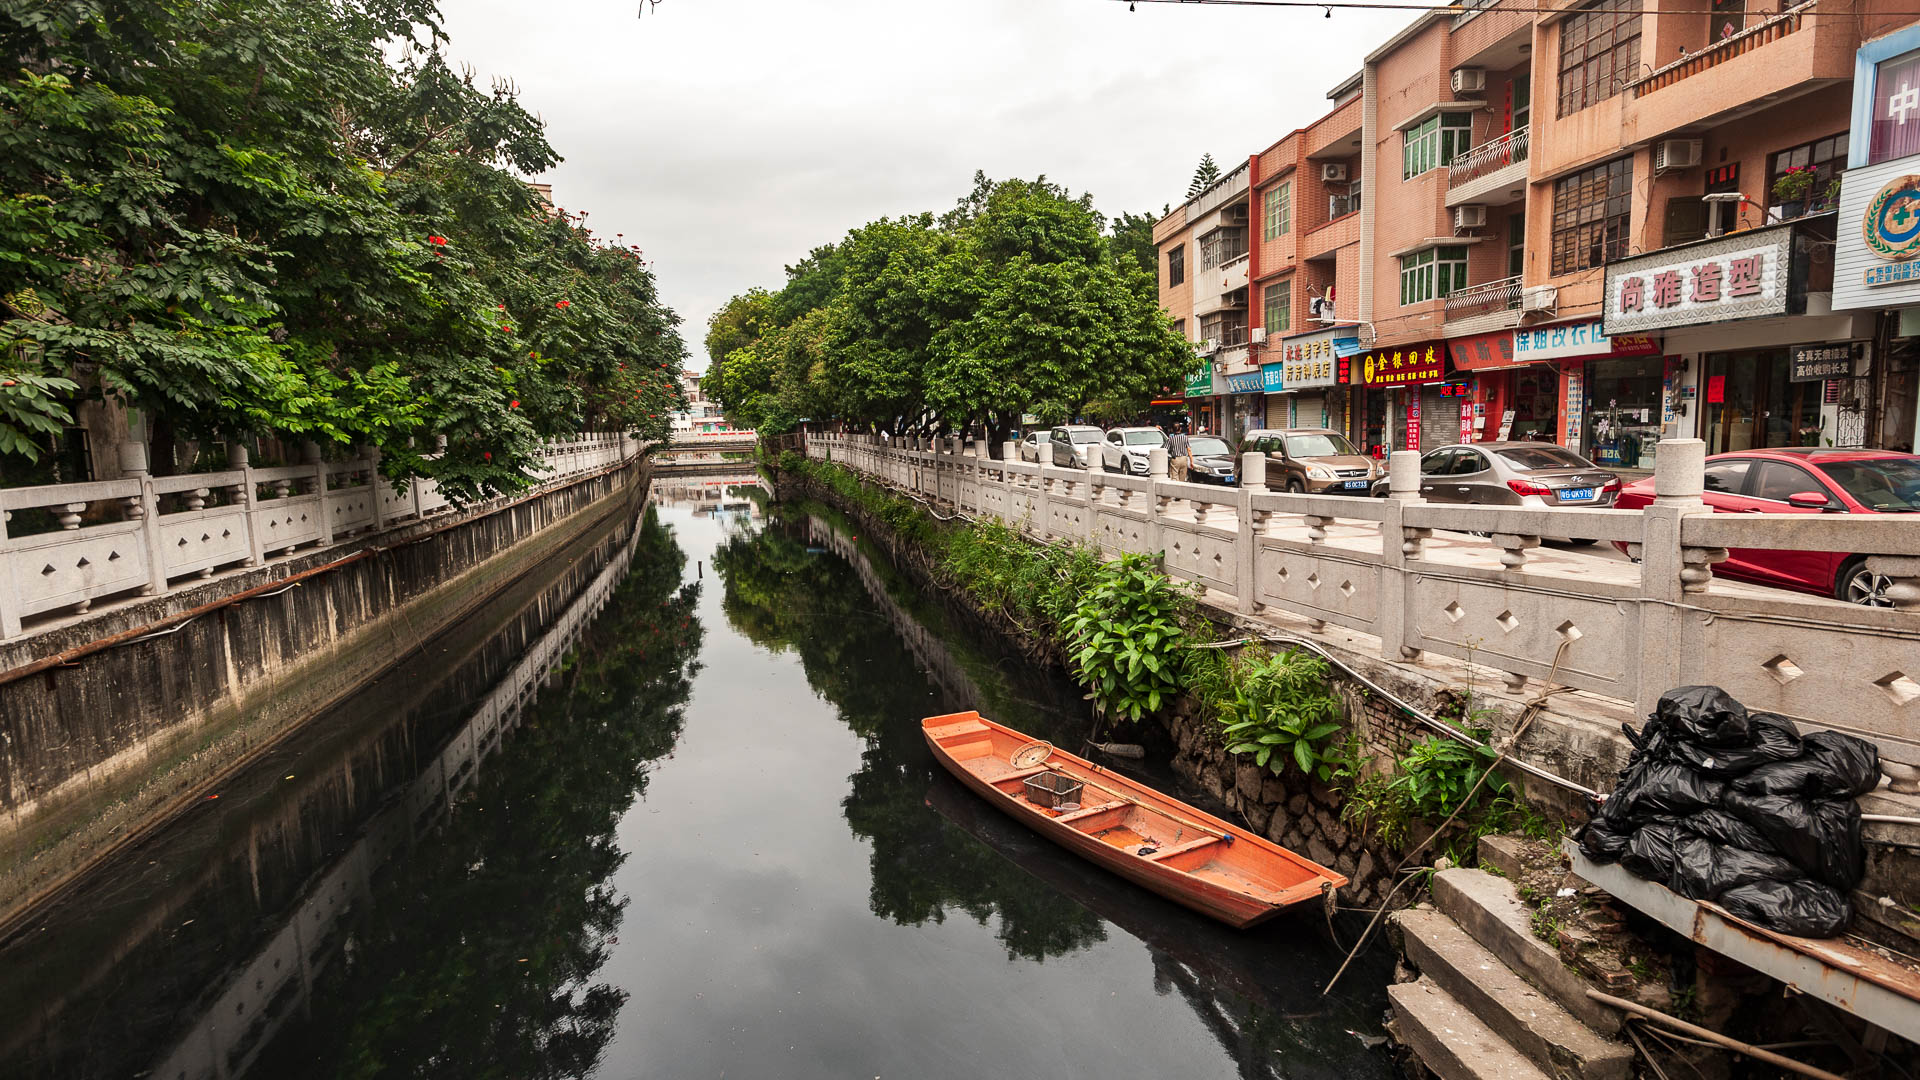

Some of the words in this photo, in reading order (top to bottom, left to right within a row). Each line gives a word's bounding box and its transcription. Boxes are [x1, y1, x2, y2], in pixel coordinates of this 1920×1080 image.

[1888, 80, 1919, 125] 中
[1619, 253, 1763, 313] 尚雅造型
[1516, 321, 1608, 352] 徐姐改衣店
[1376, 345, 1436, 371] 金银回收
[1796, 362, 1849, 377] 高价收购长发
